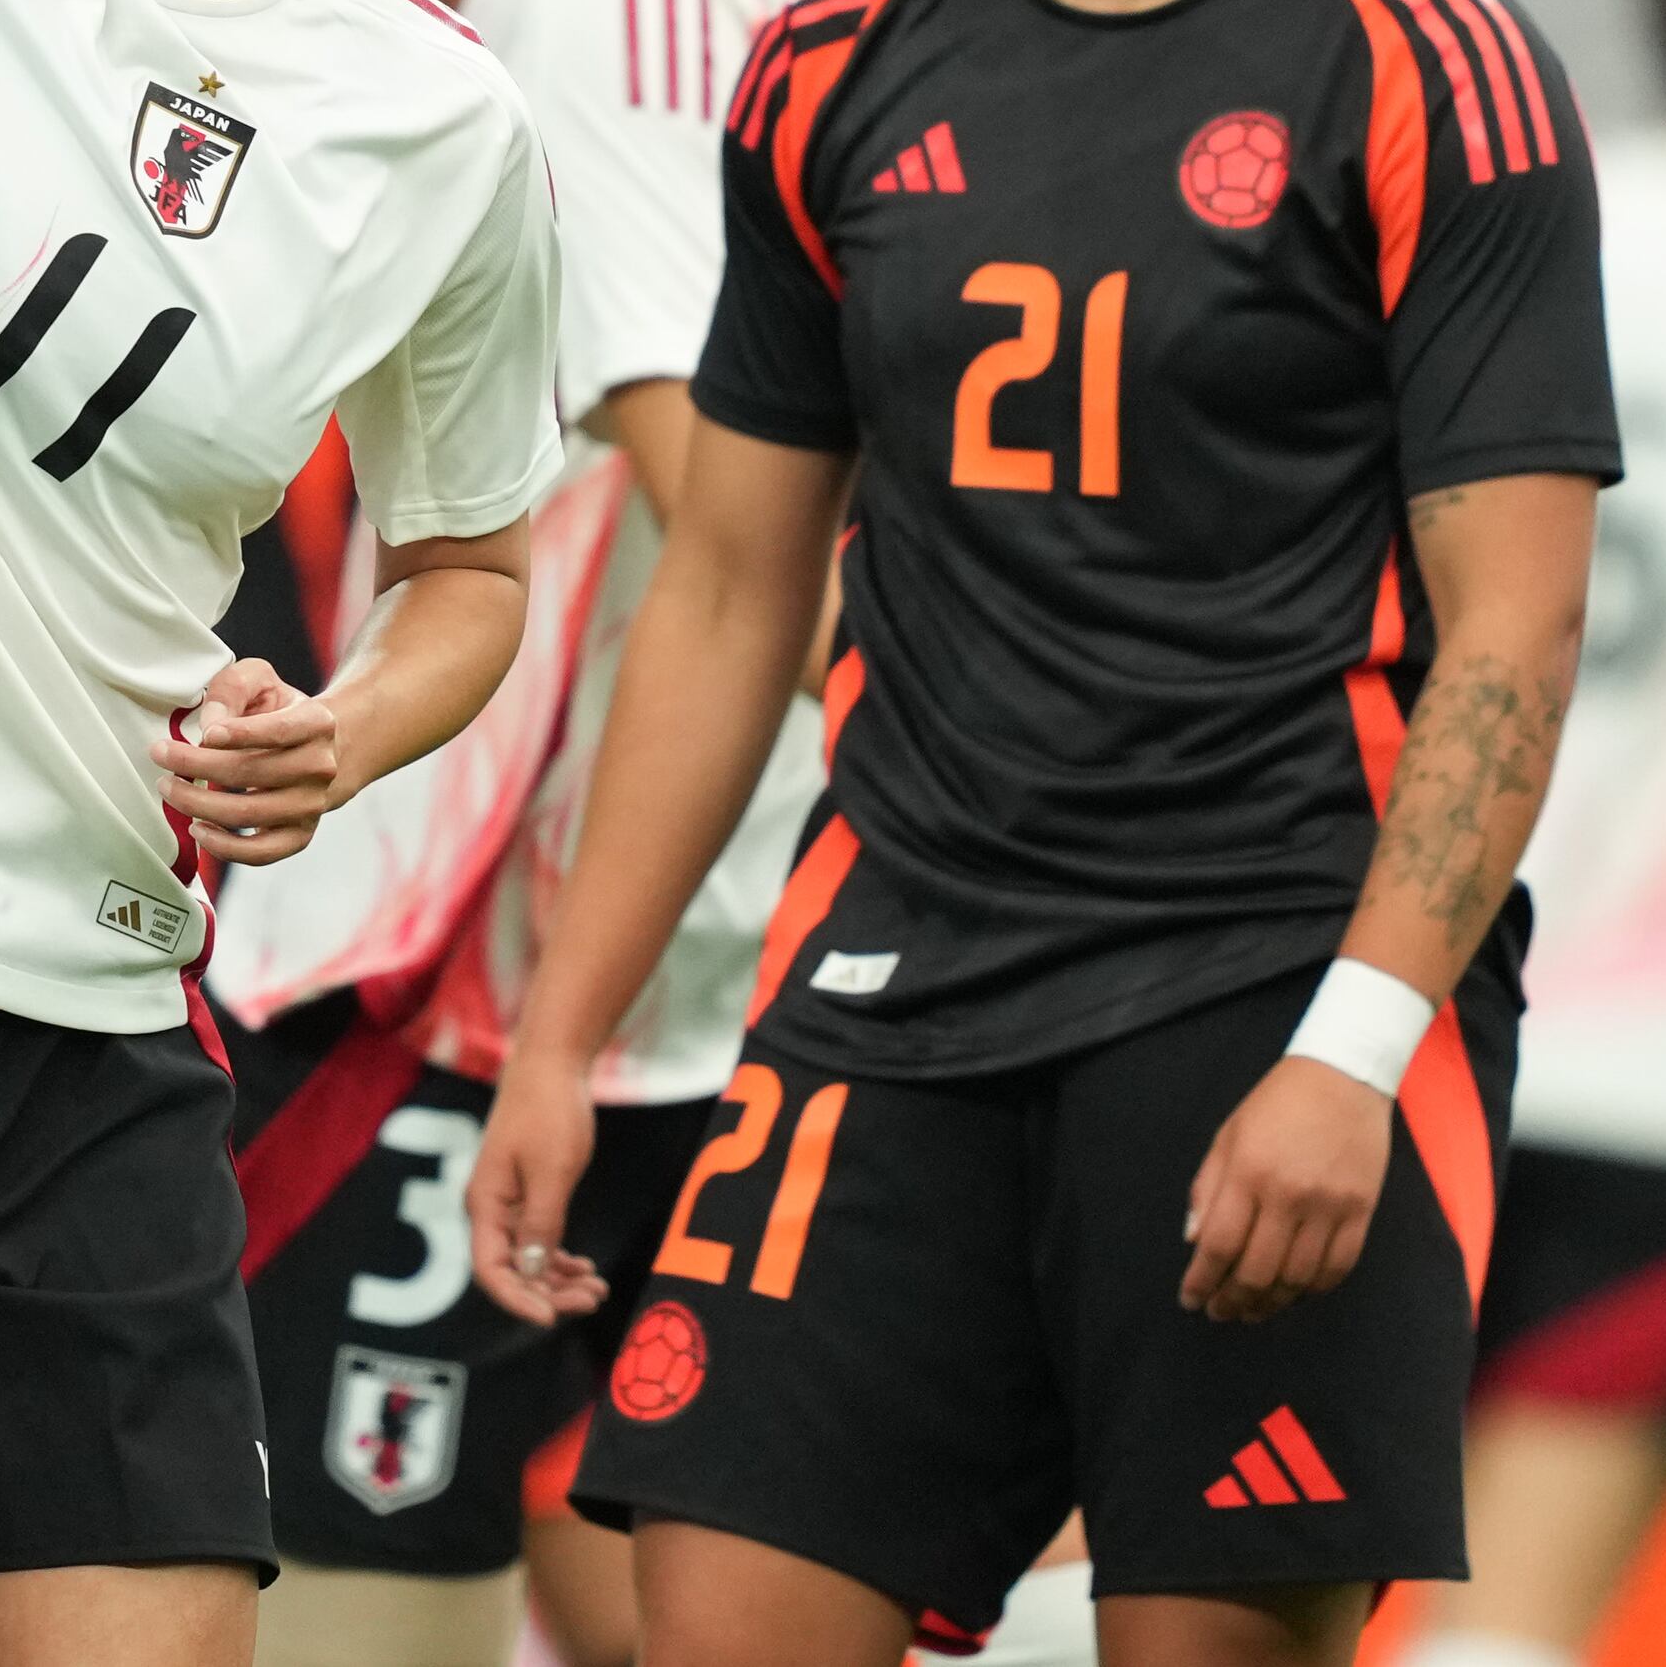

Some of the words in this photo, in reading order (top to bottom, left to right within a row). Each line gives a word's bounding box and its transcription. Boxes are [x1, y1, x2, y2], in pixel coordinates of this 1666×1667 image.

[148, 184, 187, 226] JFA
[169, 97, 231, 133] JAPAN
[949, 260, 1129, 498] 21
[347, 1106, 481, 1328] 3
[651, 1062, 850, 1301] 21
